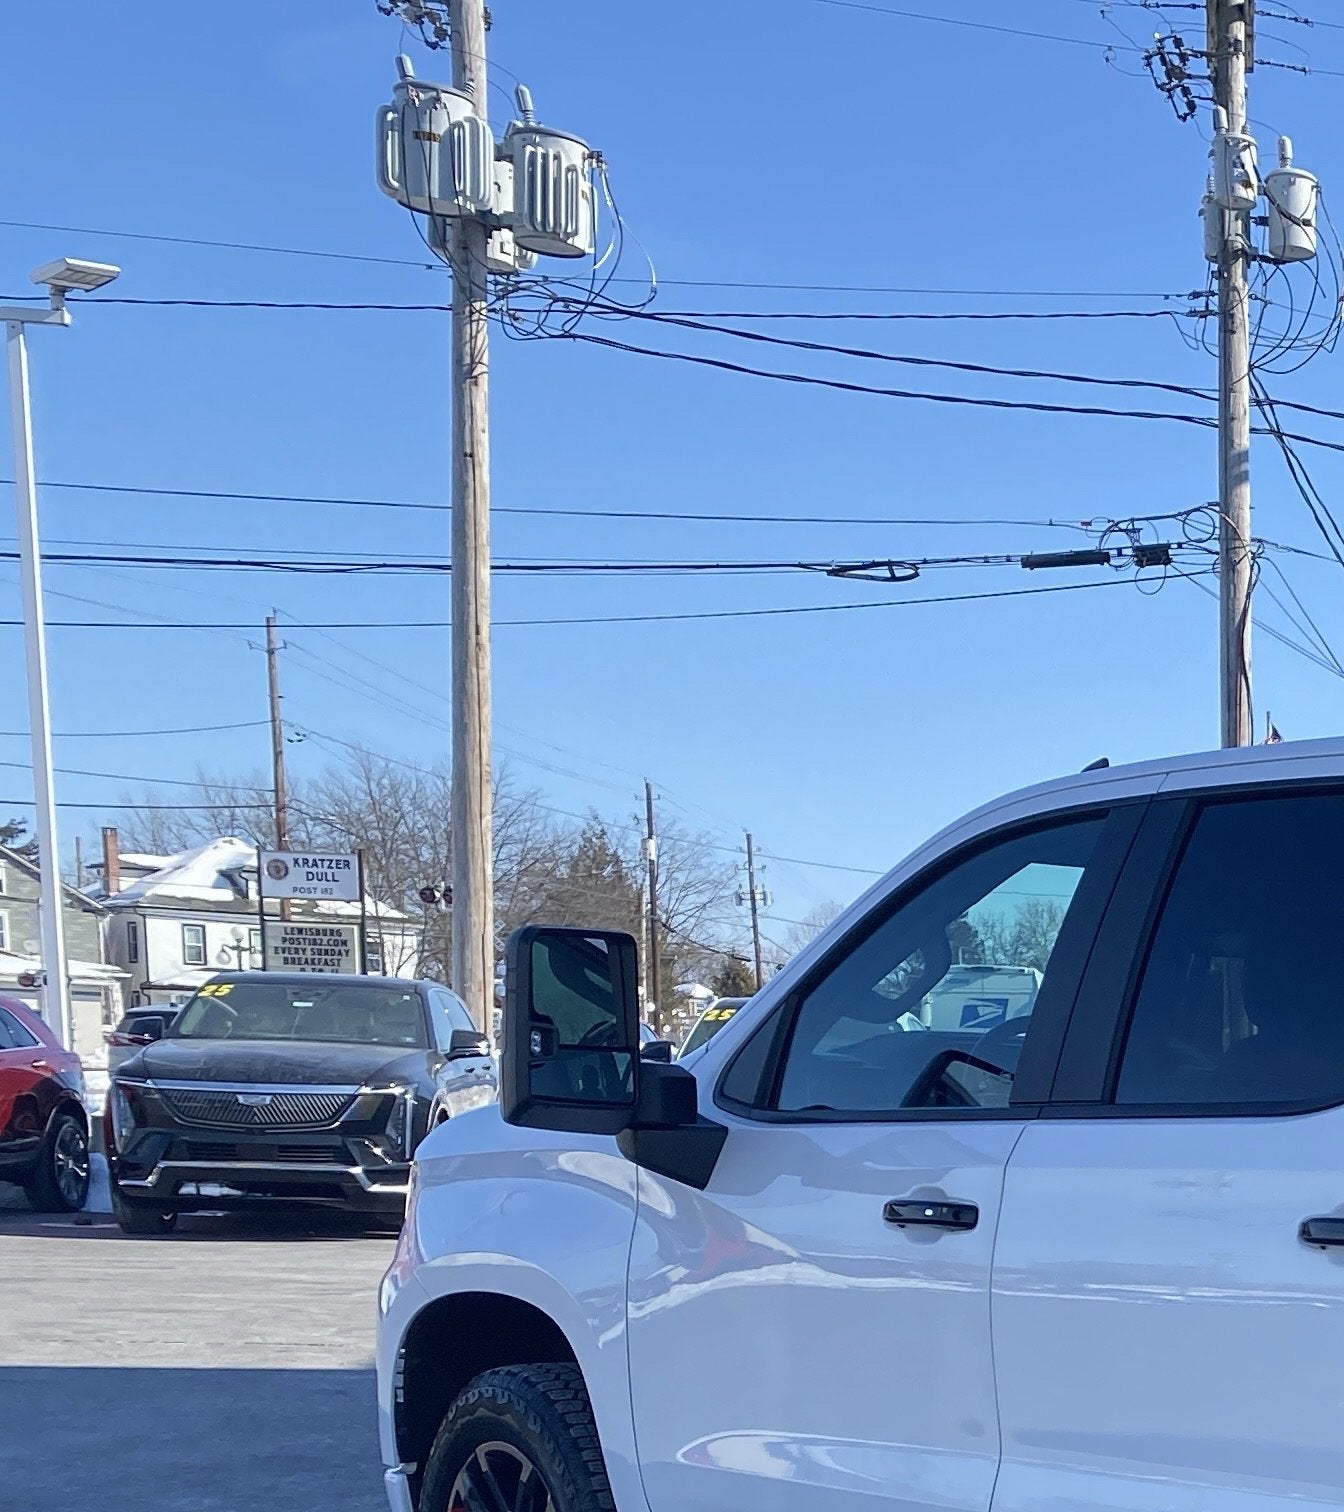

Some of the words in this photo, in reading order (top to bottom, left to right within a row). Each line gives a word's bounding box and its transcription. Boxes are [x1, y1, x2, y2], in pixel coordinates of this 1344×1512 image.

[292, 857, 351, 870] KRATZER
[305, 871, 340, 883] DULL
[292, 886, 318, 895] POST
[283, 926, 343, 937] LEWISBURG
[281, 936, 348, 947] POST182.COM
[274, 946, 307, 956] EVERY
[310, 947, 350, 957] SUNDAY
[283, 956, 342, 967] BREAKFAST
[197, 984, 235, 998] 25
[703, 1008, 737, 1021] 25
